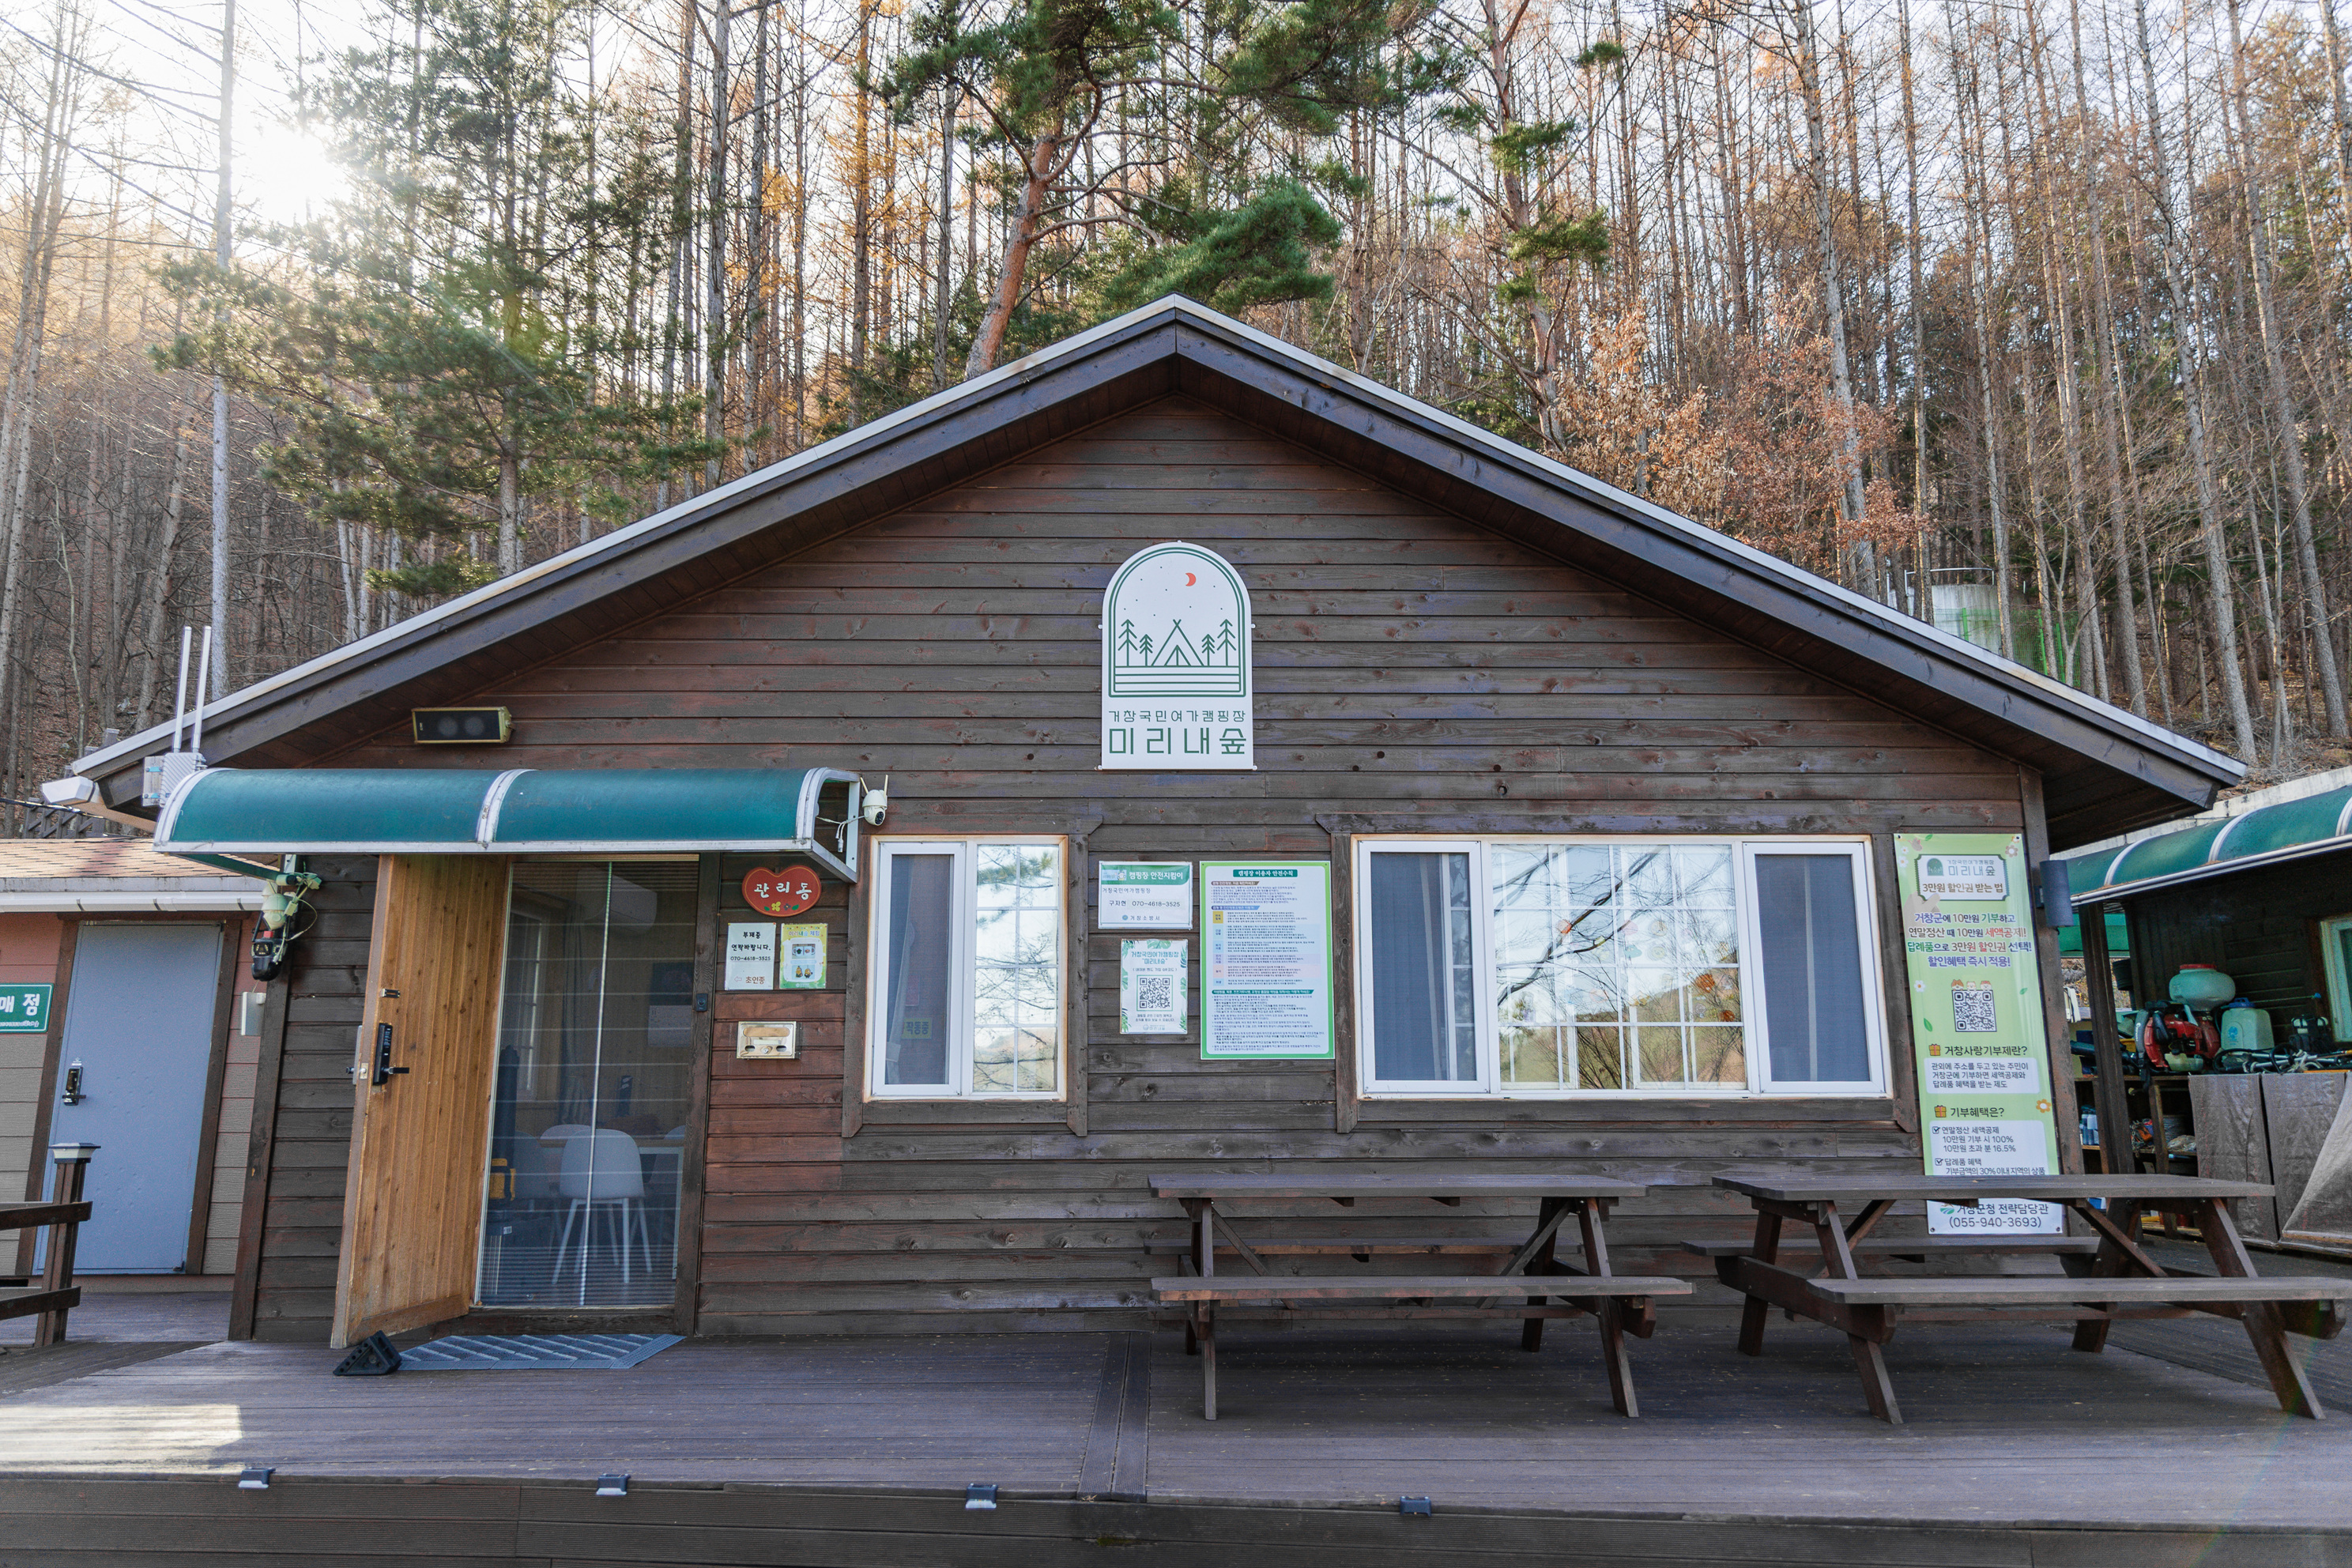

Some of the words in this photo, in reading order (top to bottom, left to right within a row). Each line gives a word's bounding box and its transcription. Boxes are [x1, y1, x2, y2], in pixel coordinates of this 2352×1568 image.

[1109, 710, 1246, 722] 거창국민여가캠핑장
[1109, 728, 1246, 754] 미리내숲
[1948, 865, 1995, 876] 미리내숲
[754, 881, 812, 900] 관리동
[1923, 884, 1945, 892] 3만원
[1947, 884, 1973, 892] 할인권
[1975, 884, 1992, 892] 받는
[1994, 884, 2003, 892] 법
[1915, 913, 1951, 923] 거창군에
[1953, 914, 1979, 923] 10만원
[1981, 914, 2015, 923] 기부하고
[1909, 928, 1944, 937] 연말정산
[1957, 929, 1983, 937] 10만원
[1985, 927, 2026, 937] 세액공제!
[1908, 942, 1950, 952] 답례품으로
[1951, 942, 1977, 952] 3만원
[1978, 942, 2006, 952] 할인권
[2008, 942, 2032, 952] 선택!
[1928, 956, 1966, 967] 할인혜택
[1968, 956, 1987, 967] 즉시
[1989, 956, 2011, 967] 적용!
[1945, 1046, 2027, 1056] 거창사랑기부제란?
[1951, 1108, 2004, 1118] 기부혜택은?
[1999, 1204, 2049, 1215] 전략담당관
[1949, 1217, 2041, 1228] (055-940-3693)
